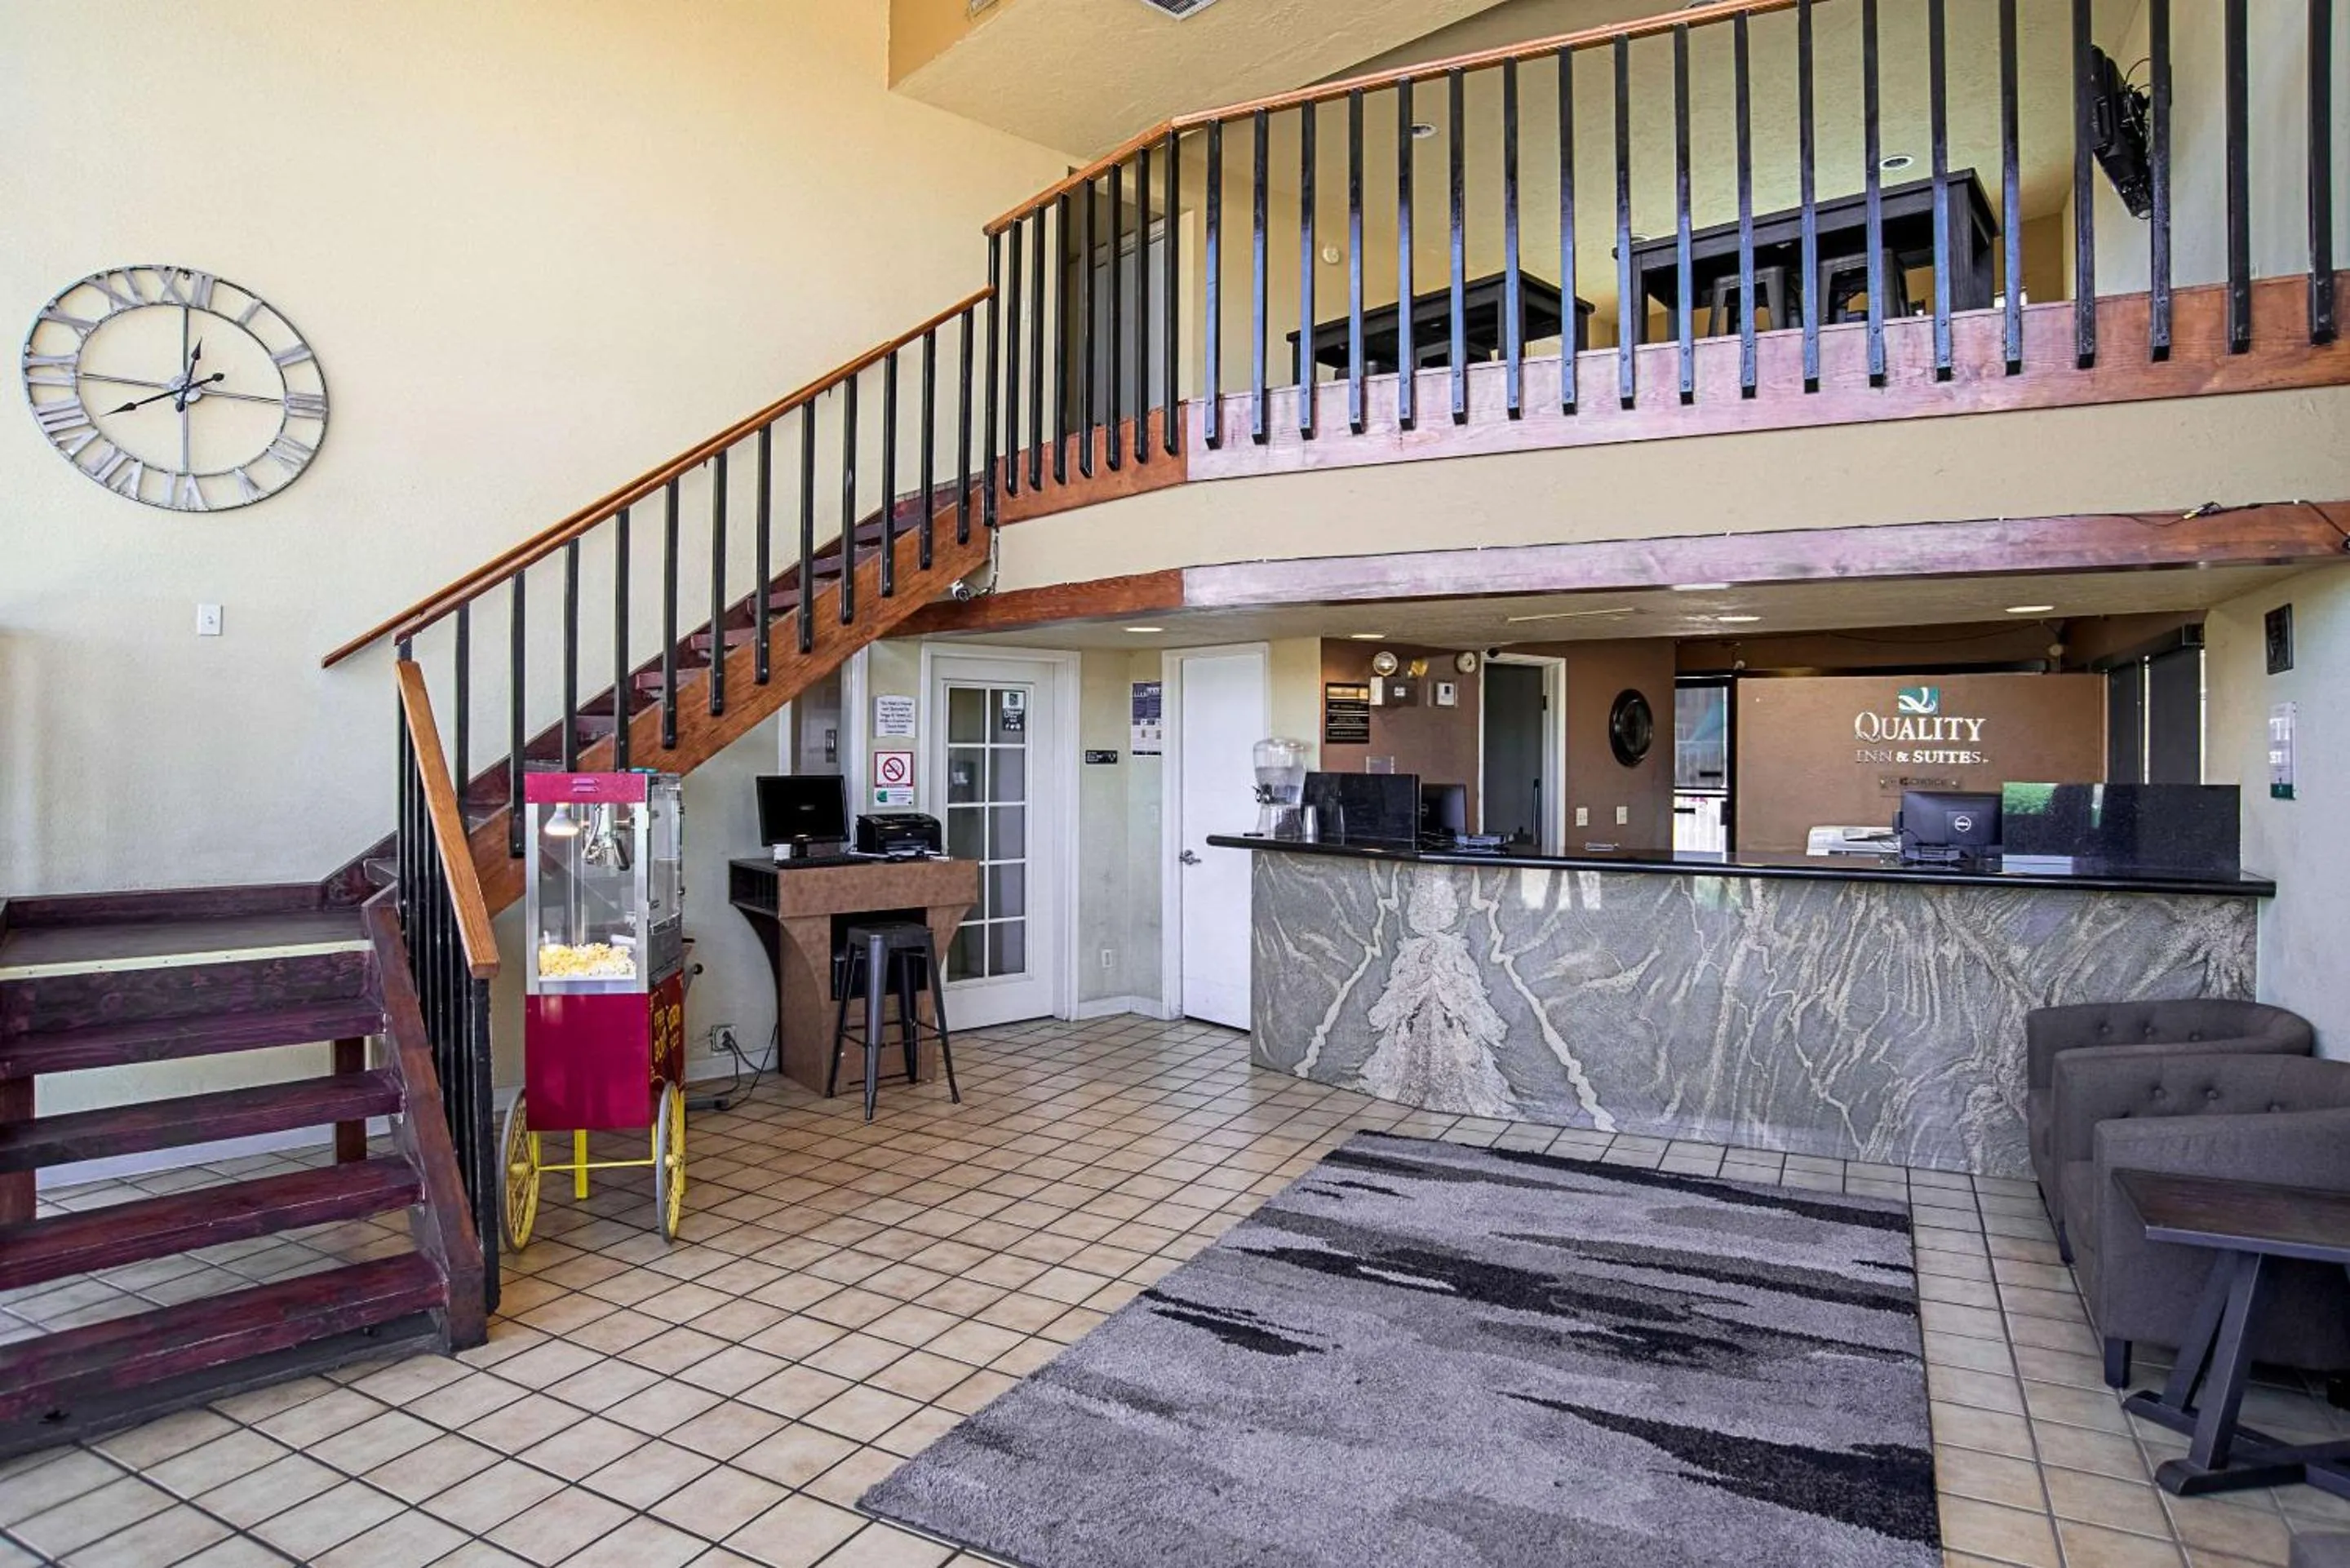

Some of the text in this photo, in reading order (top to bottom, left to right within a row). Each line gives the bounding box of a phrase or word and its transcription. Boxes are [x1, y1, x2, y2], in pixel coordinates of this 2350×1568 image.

[1854, 711, 1986, 744] QUALITY
[1856, 749, 1982, 764] INN & SUITES
